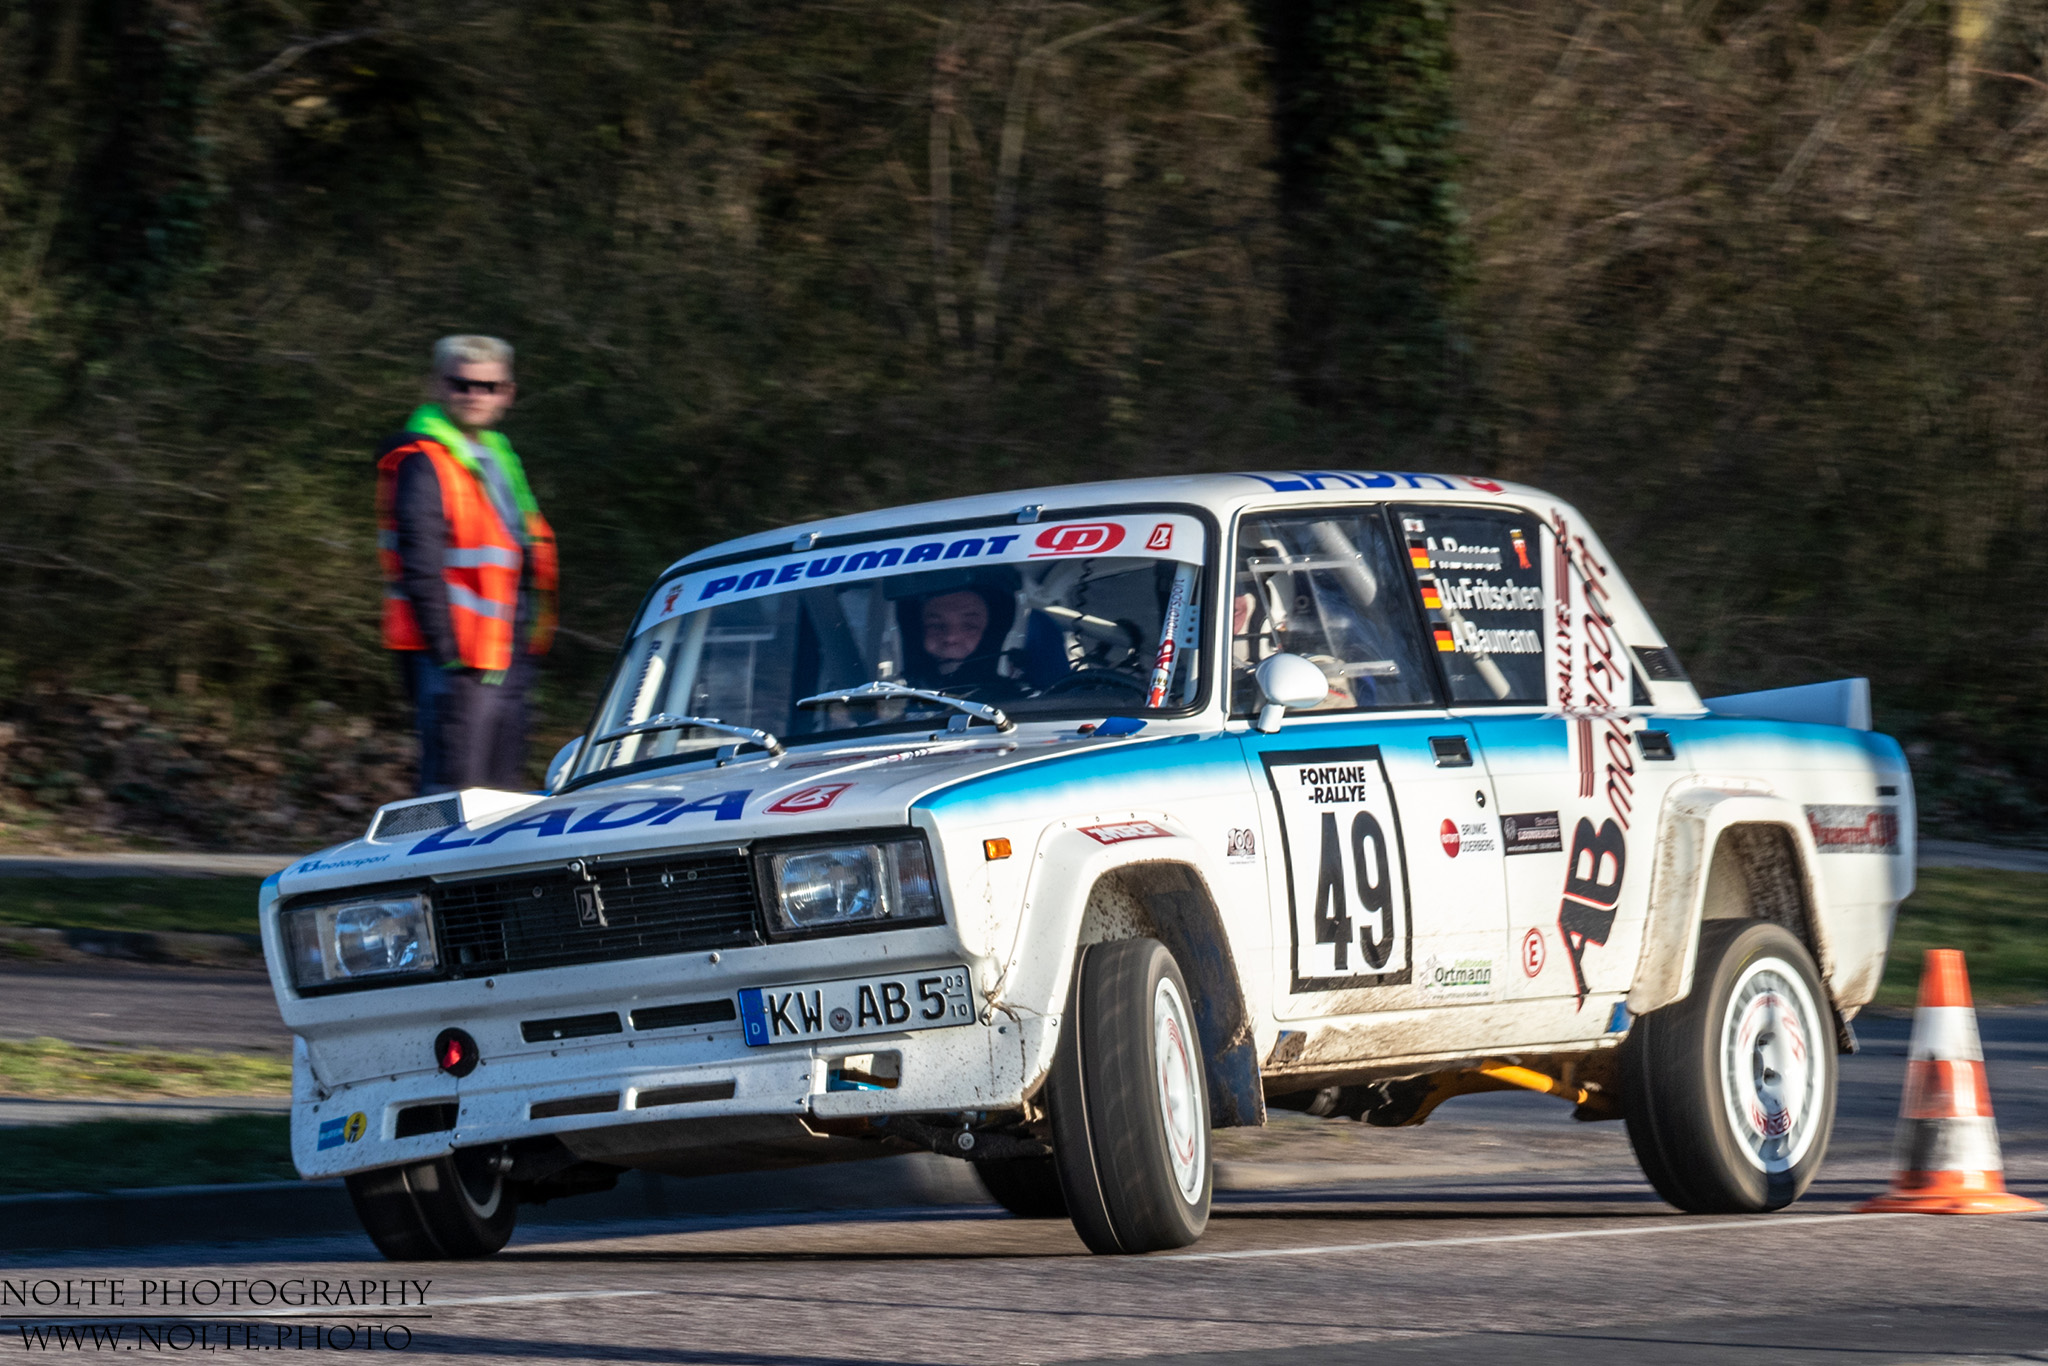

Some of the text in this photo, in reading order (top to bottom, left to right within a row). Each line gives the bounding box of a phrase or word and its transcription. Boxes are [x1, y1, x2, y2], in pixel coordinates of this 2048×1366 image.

[698, 534, 1021, 600] PNEUMANT
[1300, 766, 1366, 786] FONTANE
[407, 789, 754, 857] LADA
[1314, 810, 1394, 970] 49
[1529, 939, 1539, 967] E
[945, 974, 965, 990] 03
[1434, 966, 1492, 983] Ortmann
[768, 976, 947, 1036] KW AB 5
[951, 1003, 968, 1018] 10
[751, 1022, 761, 1036] D
